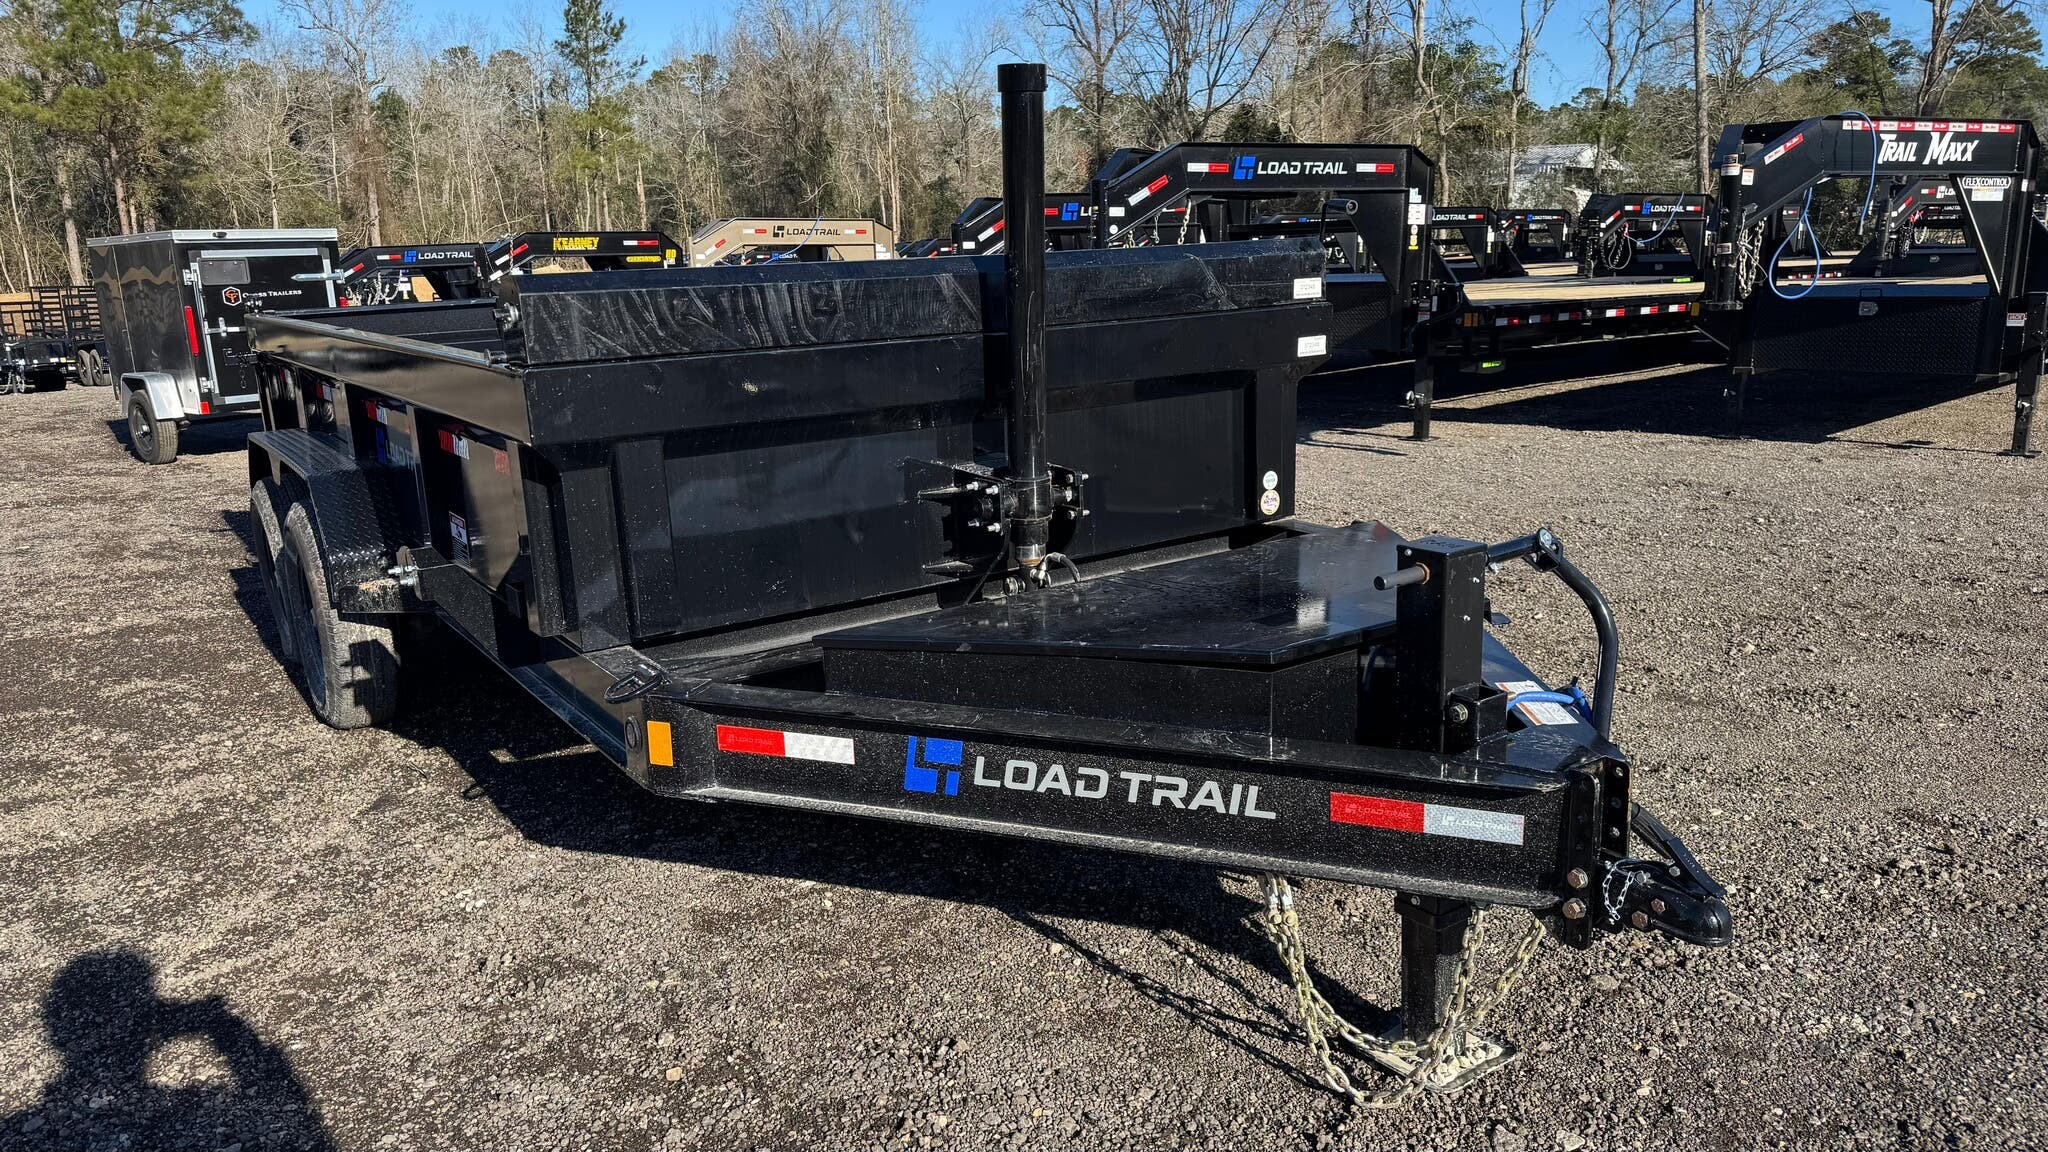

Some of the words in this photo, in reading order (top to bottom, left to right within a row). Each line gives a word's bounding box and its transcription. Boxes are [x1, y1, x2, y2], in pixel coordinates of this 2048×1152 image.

[1877, 133, 1918, 164] TRAIL
[1922, 132, 1980, 165] MAXX
[1257, 161, 1301, 174] LOAD
[1304, 161, 1348, 174] TRAIL
[814, 228, 841, 236] TRAIL
[553, 237, 600, 250] KEARNEY
[418, 252, 445, 260] LOAD
[445, 251, 474, 259] TRAIL
[973, 755, 1109, 799] LOAD
[1120, 771, 1276, 820] TRAIL
